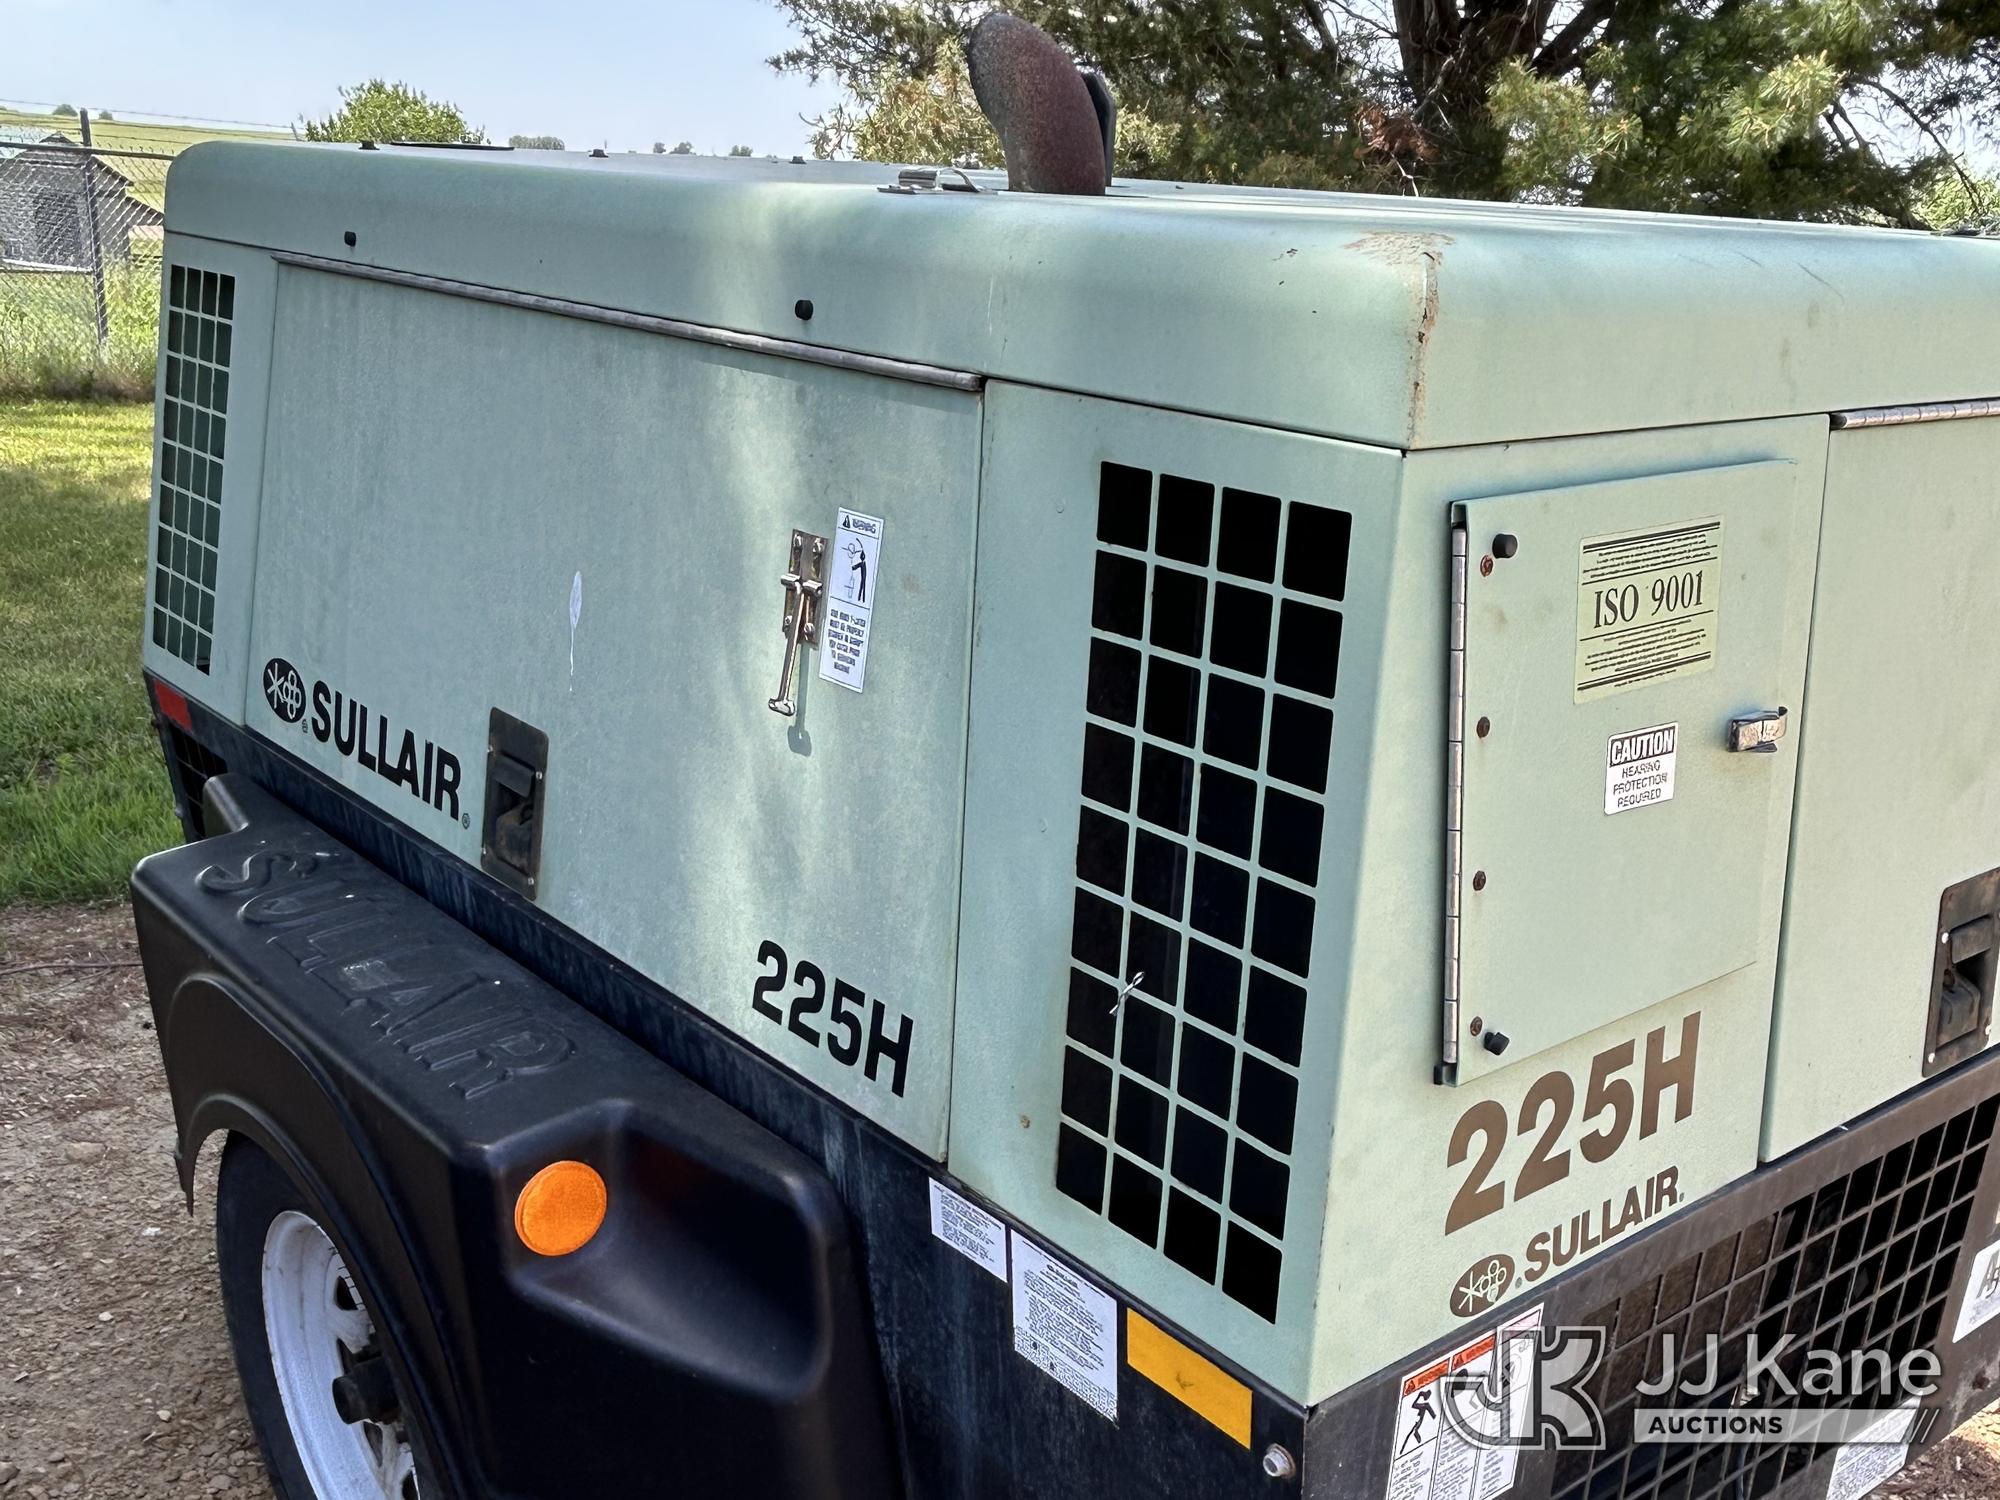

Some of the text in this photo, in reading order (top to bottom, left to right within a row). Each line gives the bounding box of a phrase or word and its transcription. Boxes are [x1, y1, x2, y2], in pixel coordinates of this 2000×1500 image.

[1593, 570, 1703, 629] ISO 9001
[311, 679, 462, 821] SULLAIR
[1611, 728, 1674, 765] CAUTION
[1613, 772, 1668, 795] PROTECTION
[1617, 788, 1662, 808] REQUIRED
[752, 939, 914, 1098] 225H
[1444, 1011, 1701, 1236] 225H
[1523, 1165, 1679, 1283] SULLAIR
